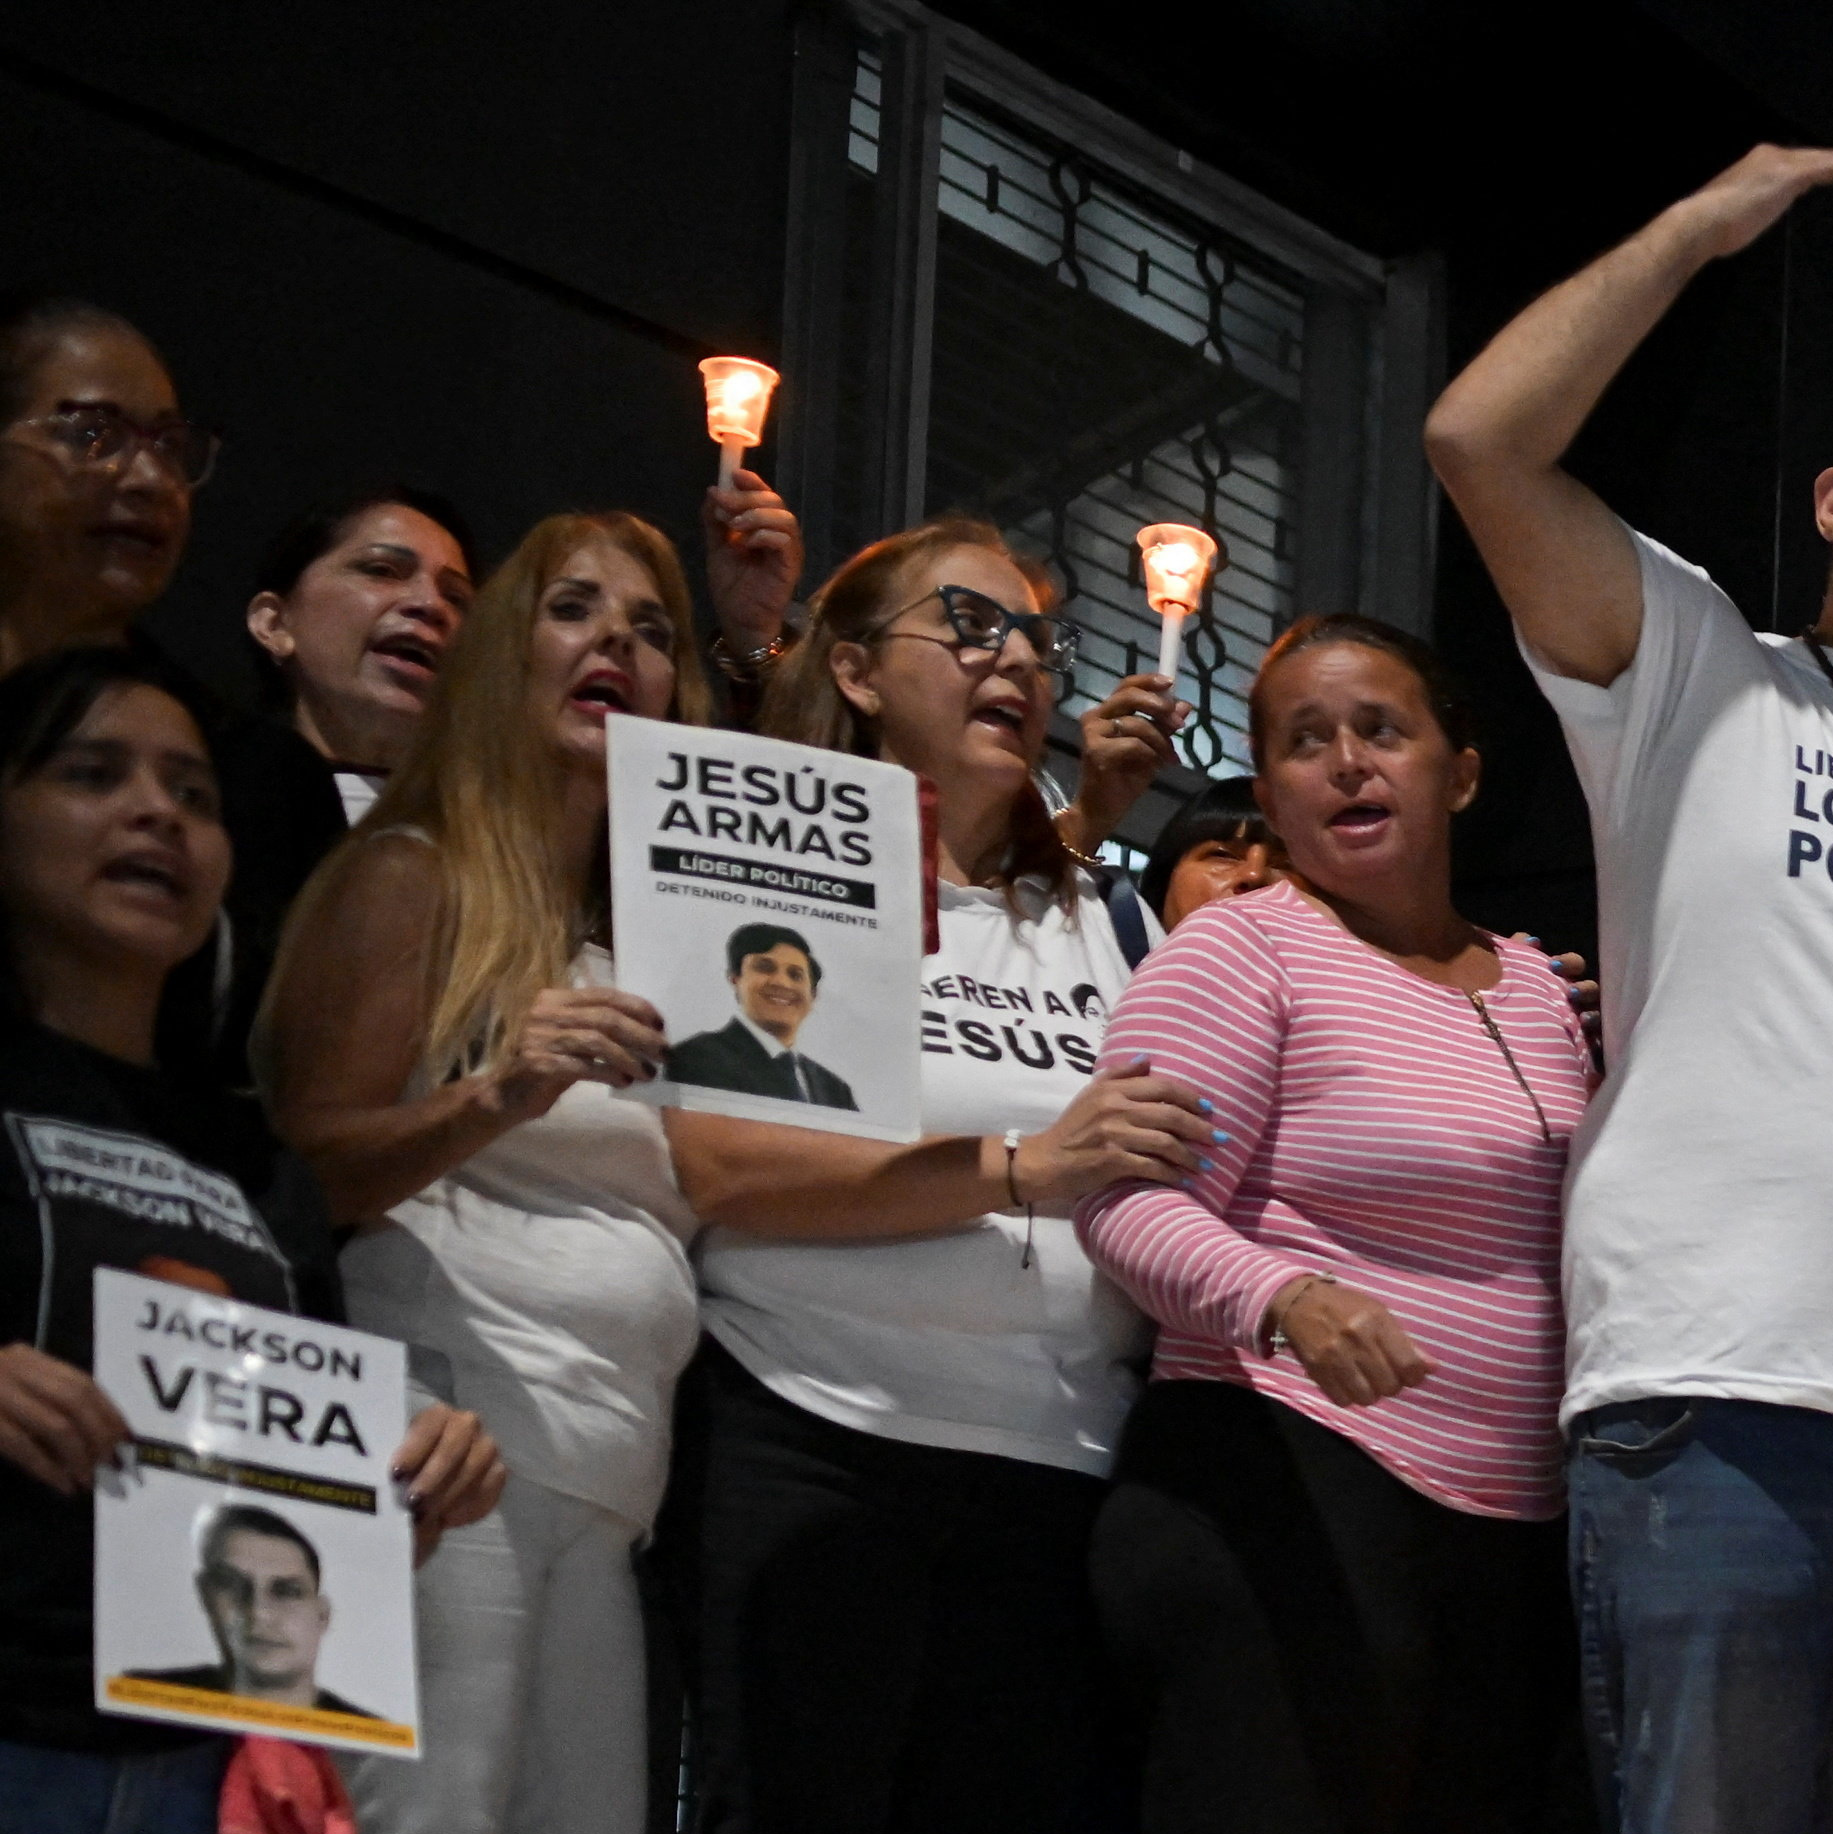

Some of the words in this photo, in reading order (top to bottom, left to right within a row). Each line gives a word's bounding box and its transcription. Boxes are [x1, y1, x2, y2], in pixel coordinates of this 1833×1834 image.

[656, 752, 868, 824] JESÚS
[658, 799, 873, 867] ARMAS
[656, 881, 746, 906] DETENIDO
[751, 895, 879, 930] INJUSTAMENTE
[680, 852, 745, 880] LÍDER
[750, 864, 848, 899] POLÍTICO
[1043, 991, 1072, 1017] A
[921, 1010, 1097, 1075] ESÚS
[138, 1301, 362, 1382] JACKSON
[139, 1355, 369, 1457] VERA
